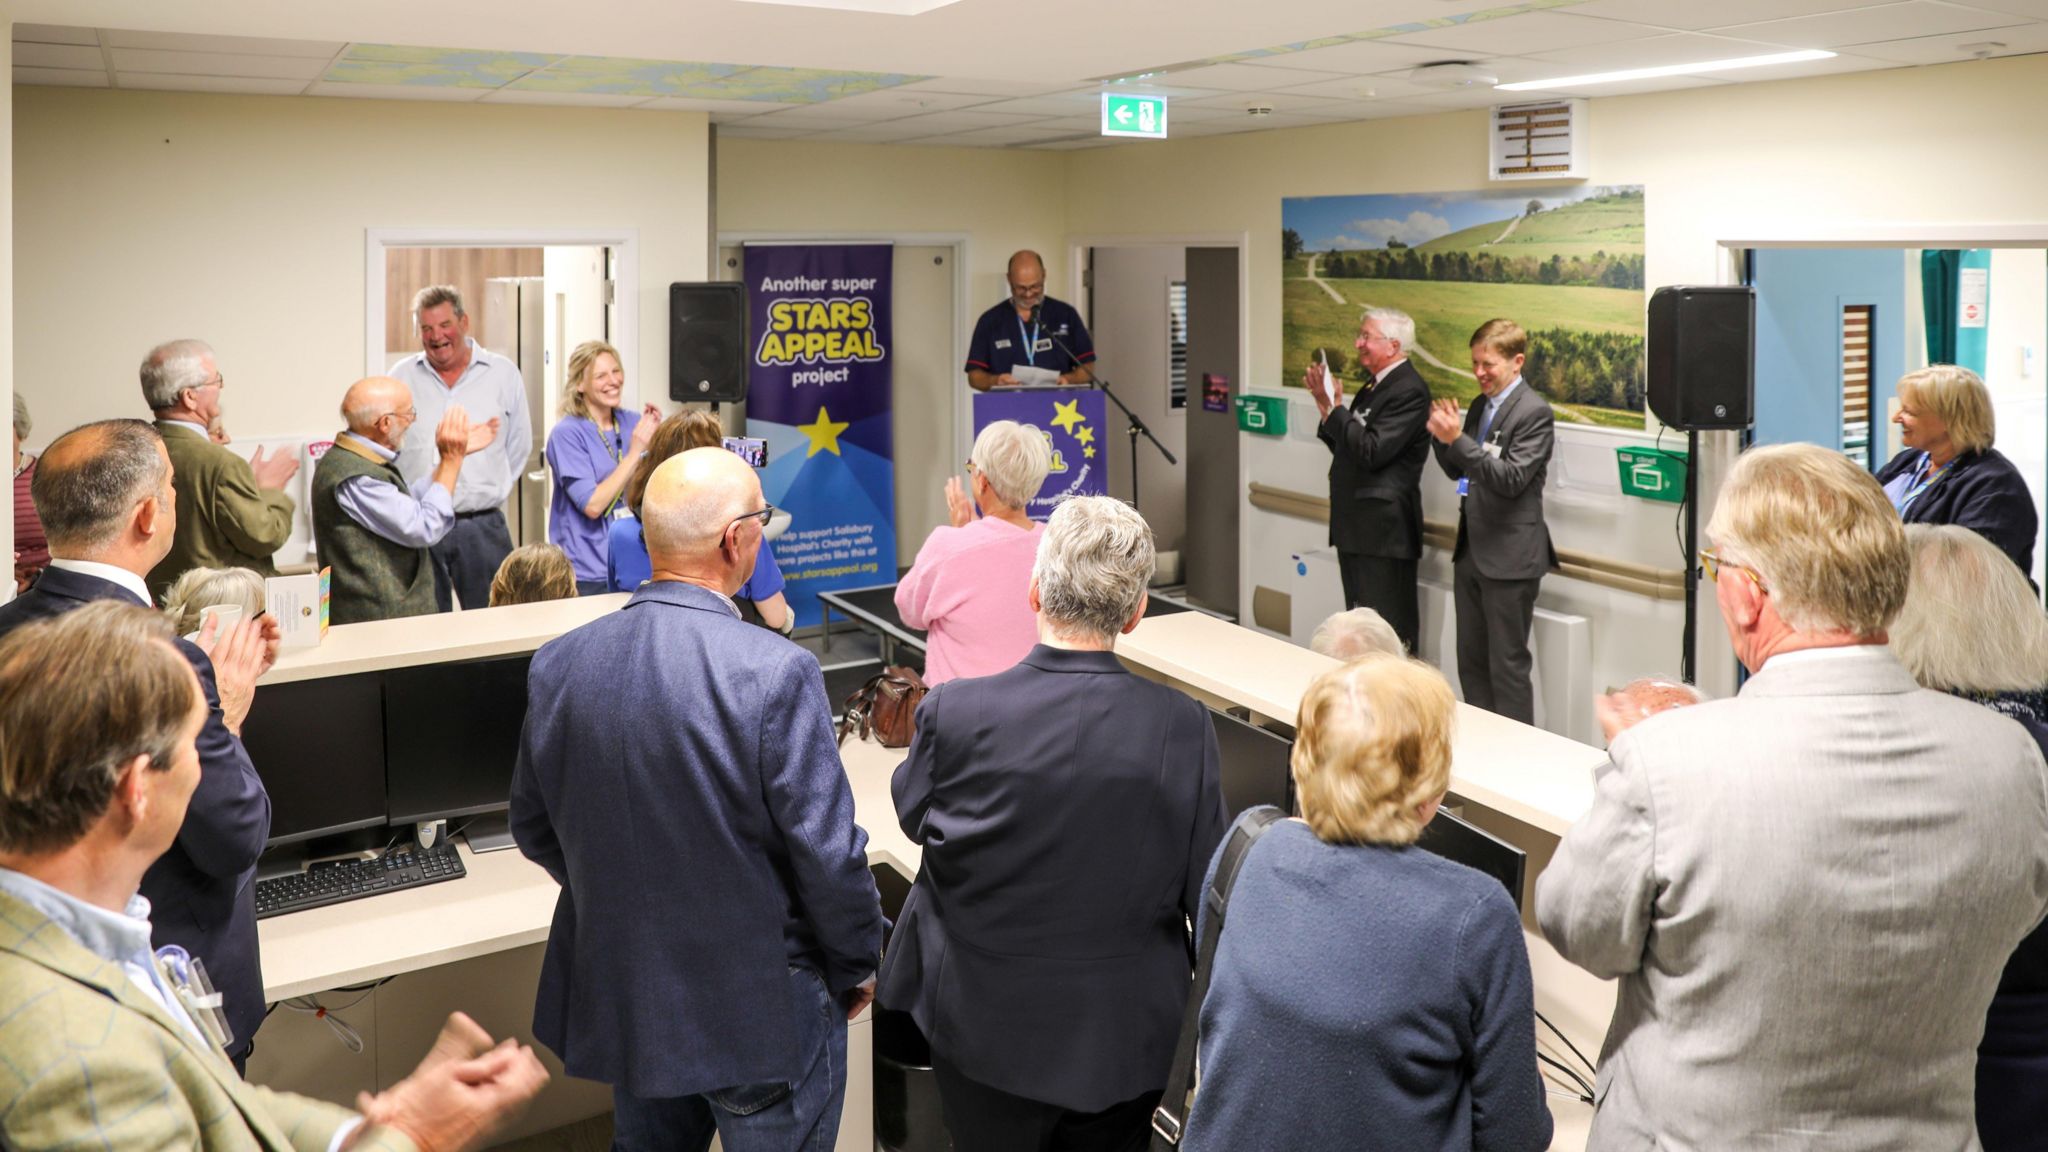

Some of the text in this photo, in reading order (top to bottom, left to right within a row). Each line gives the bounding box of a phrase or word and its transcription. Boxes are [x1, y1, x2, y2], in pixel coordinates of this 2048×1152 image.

[761, 276, 877, 293] Another super
[771, 301, 870, 331] STARS
[760, 331, 881, 362] APPEAL
[792, 367, 849, 388] project
[799, 529, 832, 540] support
[835, 525, 873, 535] Salisbury
[777, 535, 873, 554] Hospital's Charity with
[797, 552, 832, 565] projects
[834, 549, 849, 559] like
[851, 548, 866, 557] this
[867, 547, 878, 556] at
